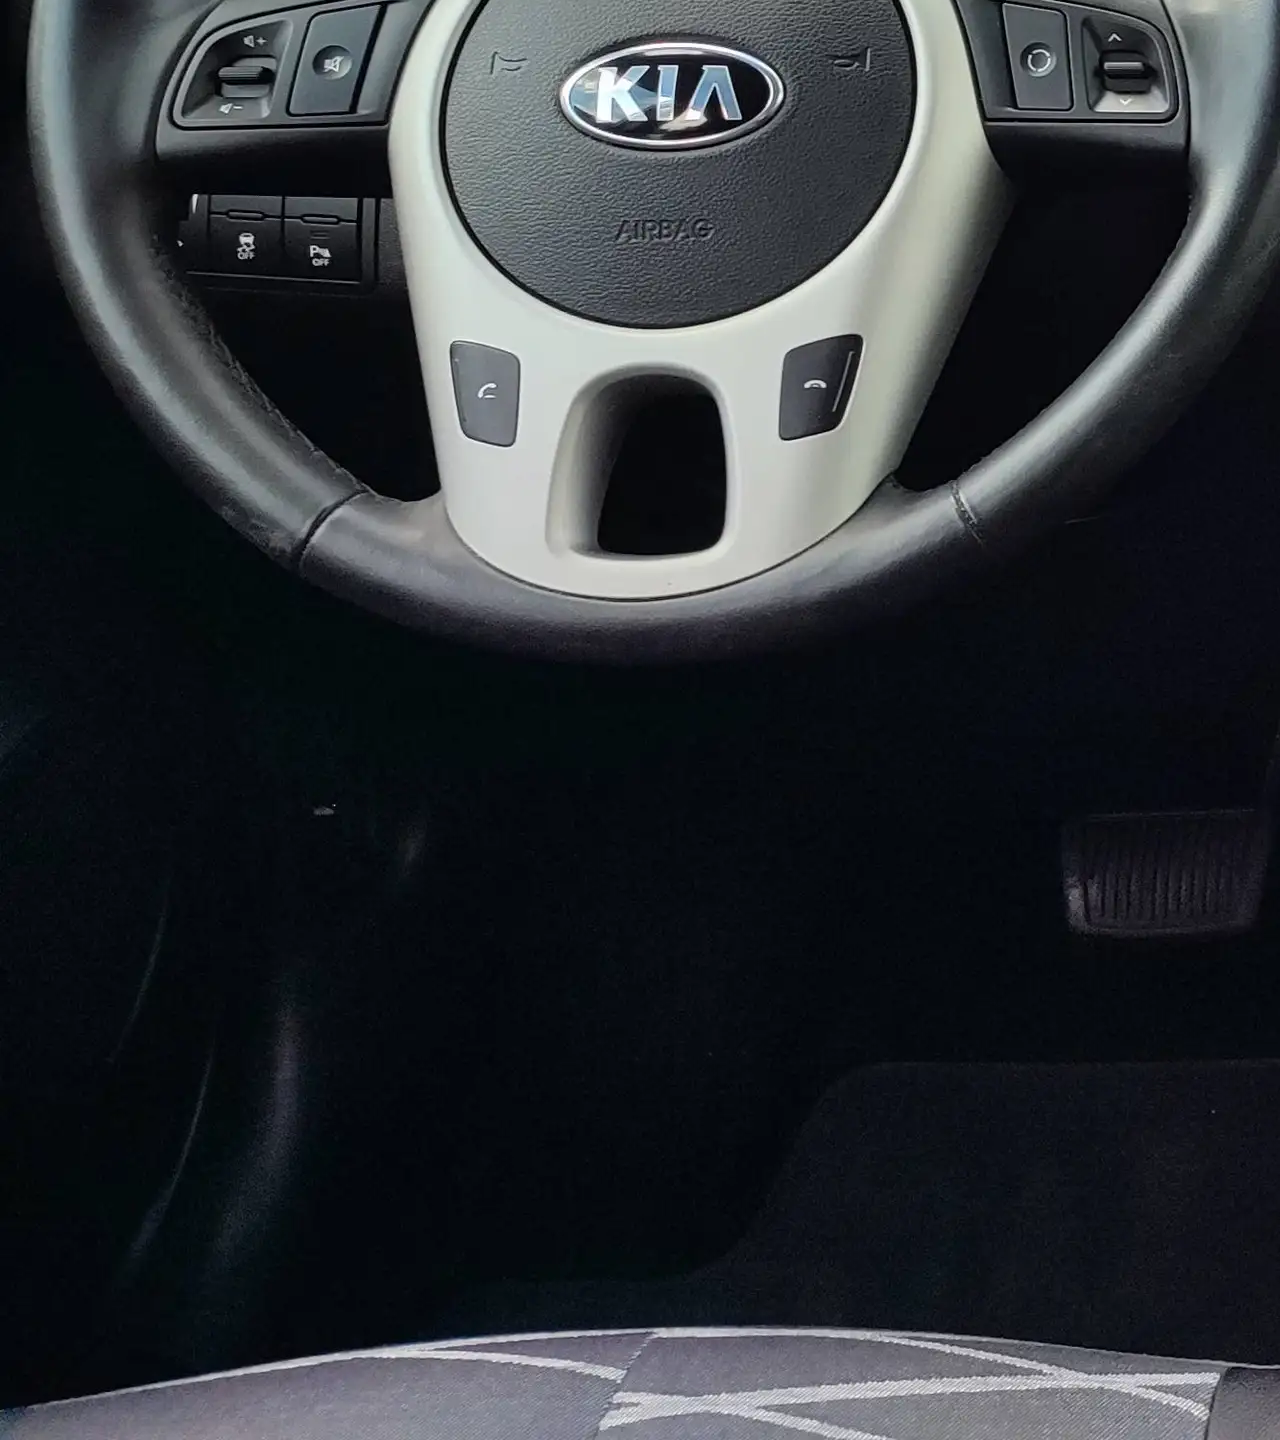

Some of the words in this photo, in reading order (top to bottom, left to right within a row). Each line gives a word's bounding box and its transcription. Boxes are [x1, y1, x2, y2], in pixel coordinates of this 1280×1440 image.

[594, 64, 743, 122] KIA
[613, 219, 714, 242] AIRBAG
[237, 251, 255, 260] OFF
[311, 258, 330, 267] OFF
